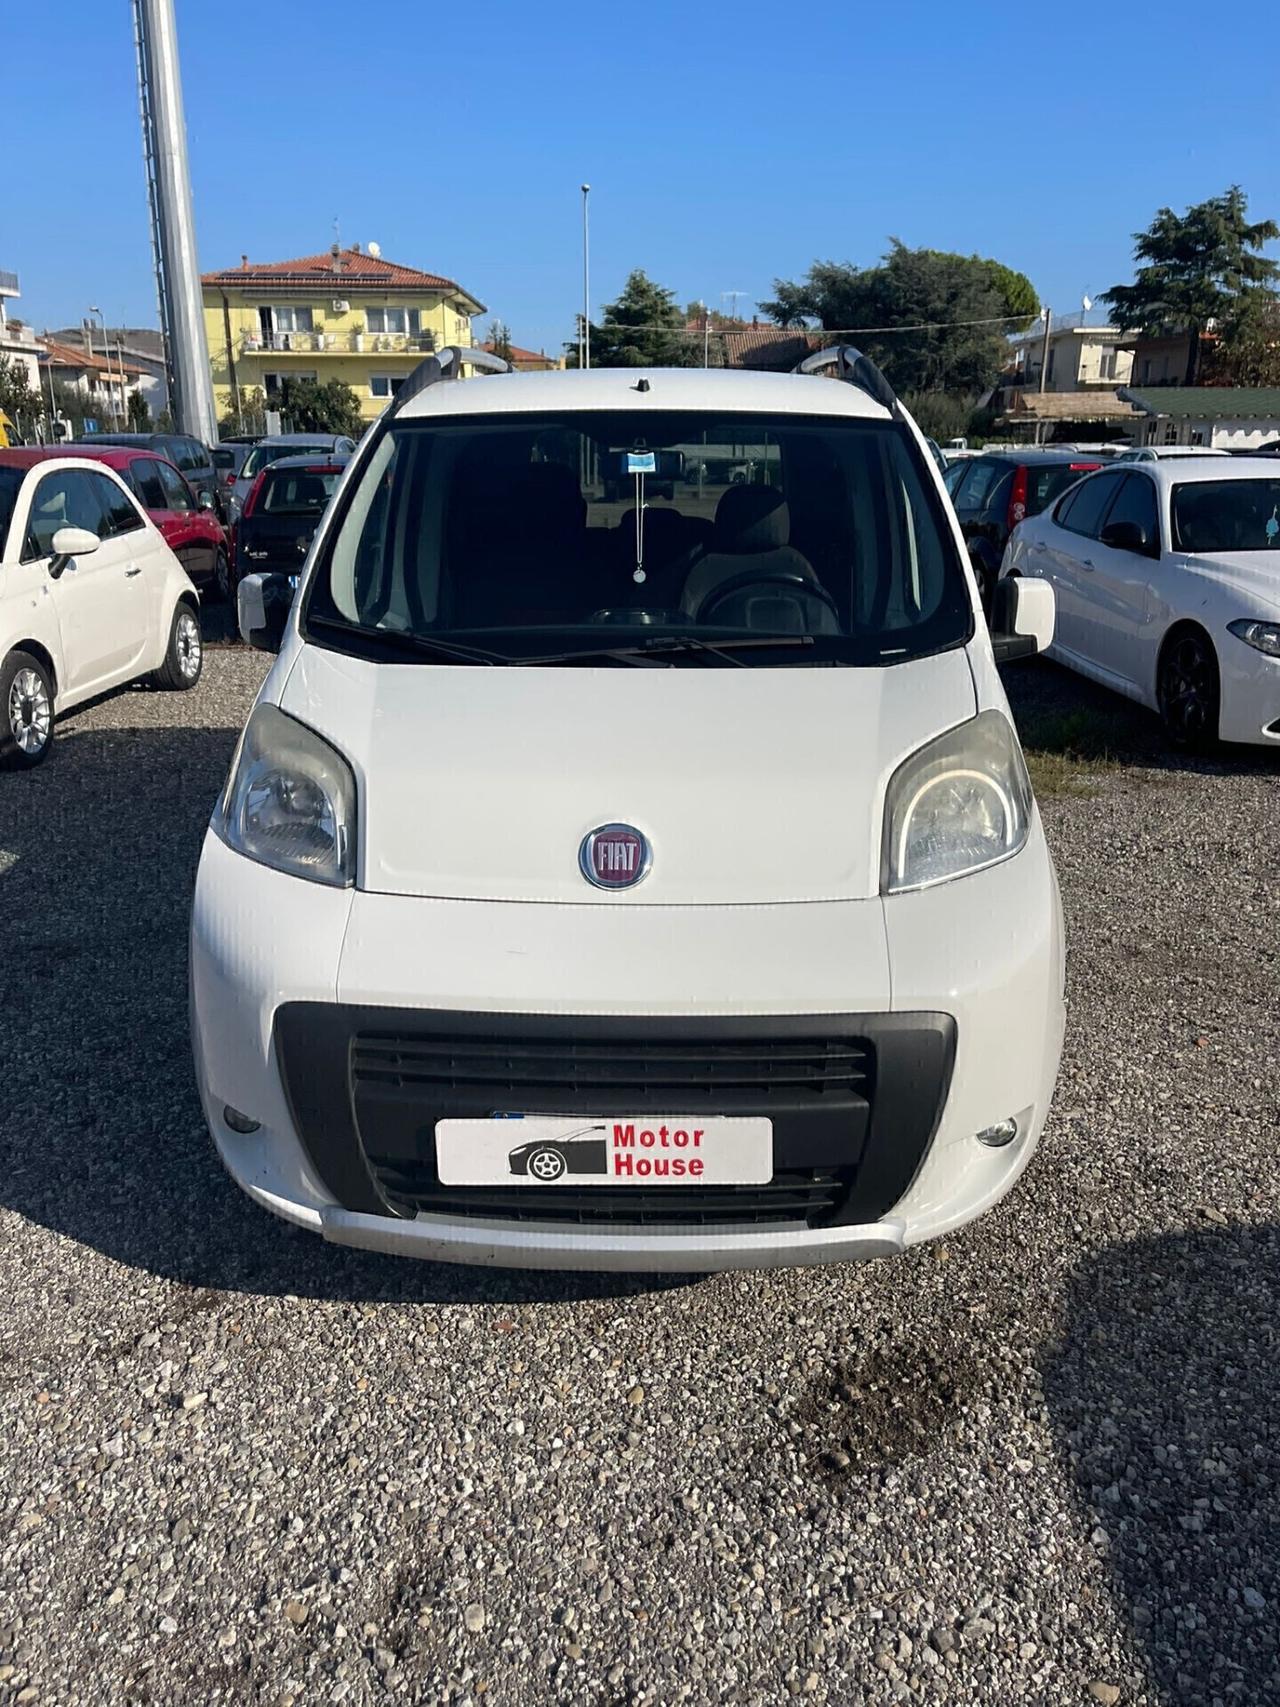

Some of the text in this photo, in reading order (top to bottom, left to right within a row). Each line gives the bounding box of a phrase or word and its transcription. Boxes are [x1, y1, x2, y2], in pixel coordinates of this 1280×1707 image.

[597, 841, 637, 871] FIAT
[613, 1124, 705, 1148] Motor
[613, 1153, 705, 1176] House
